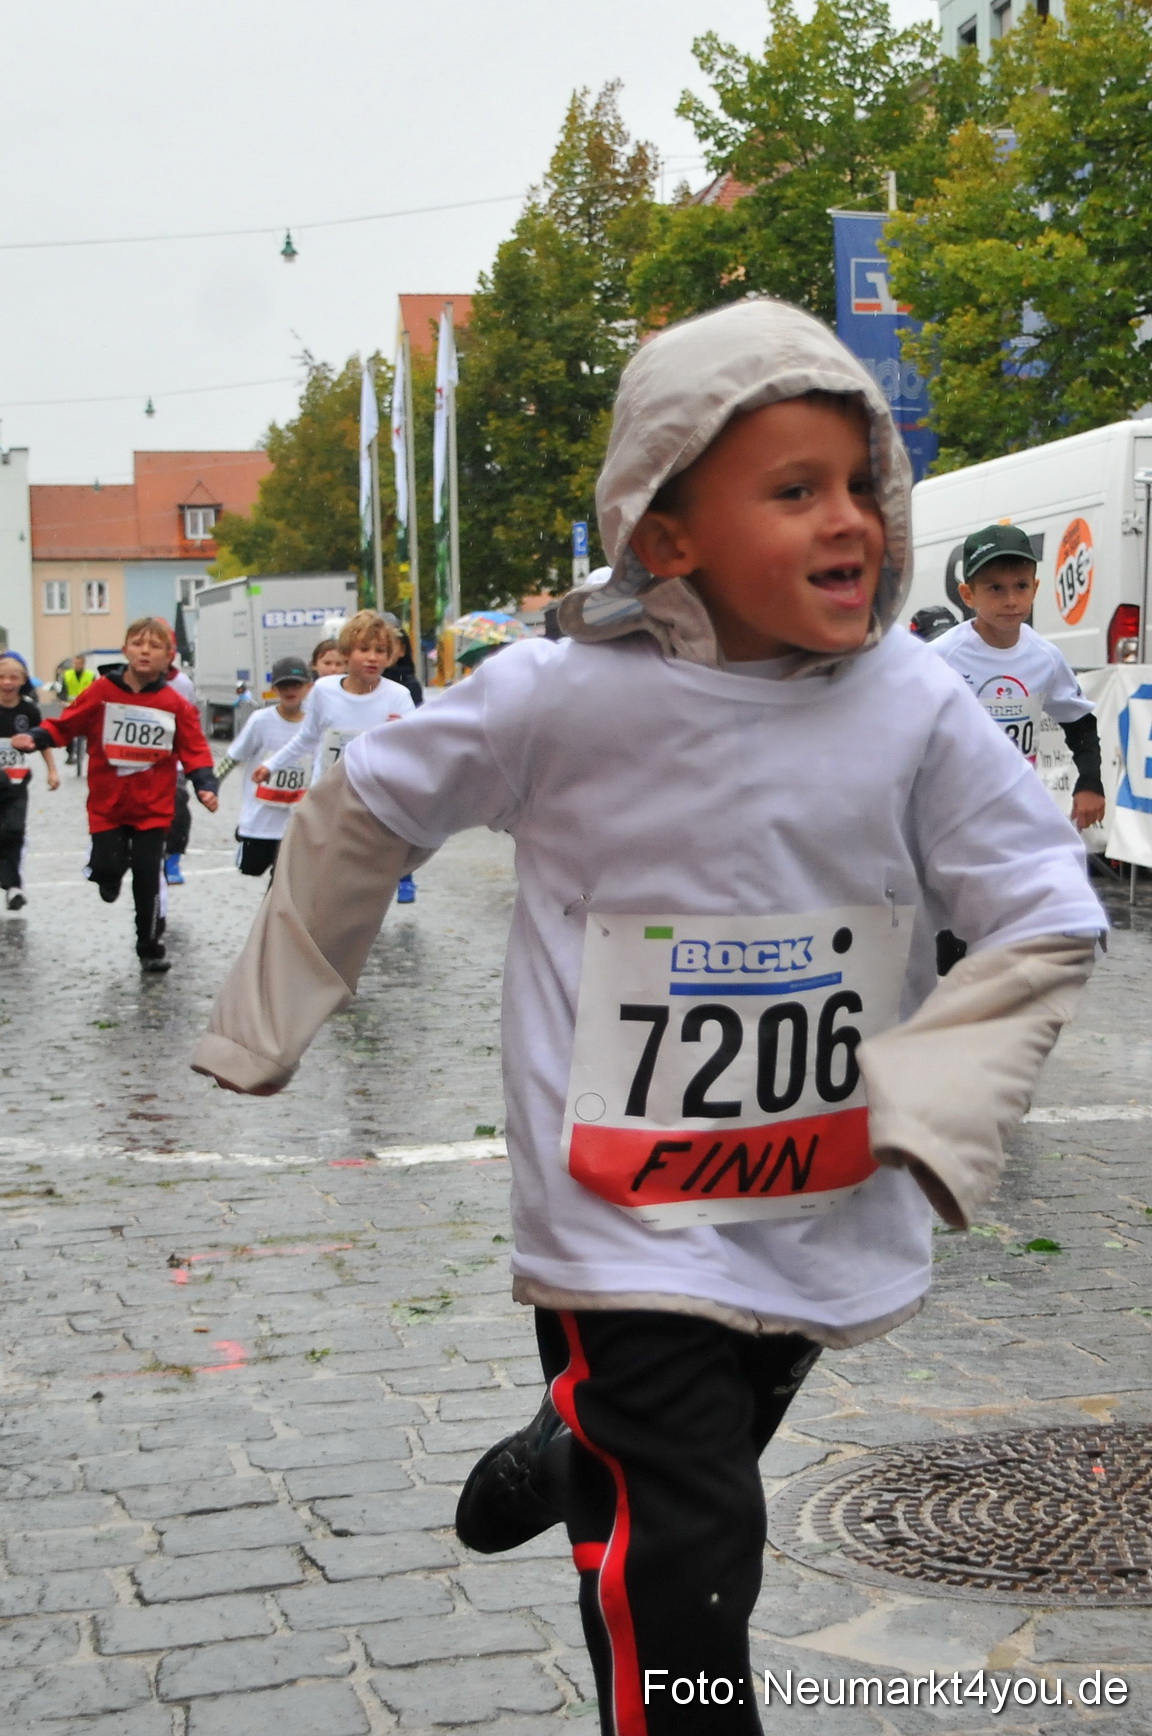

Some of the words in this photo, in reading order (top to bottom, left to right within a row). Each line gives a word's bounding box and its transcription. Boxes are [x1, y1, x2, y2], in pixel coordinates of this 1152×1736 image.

[112, 720, 166, 746] 7082
[671, 936, 814, 973] BOCK
[620, 989, 864, 1118] 7206
[631, 1134, 819, 1193] FINN
